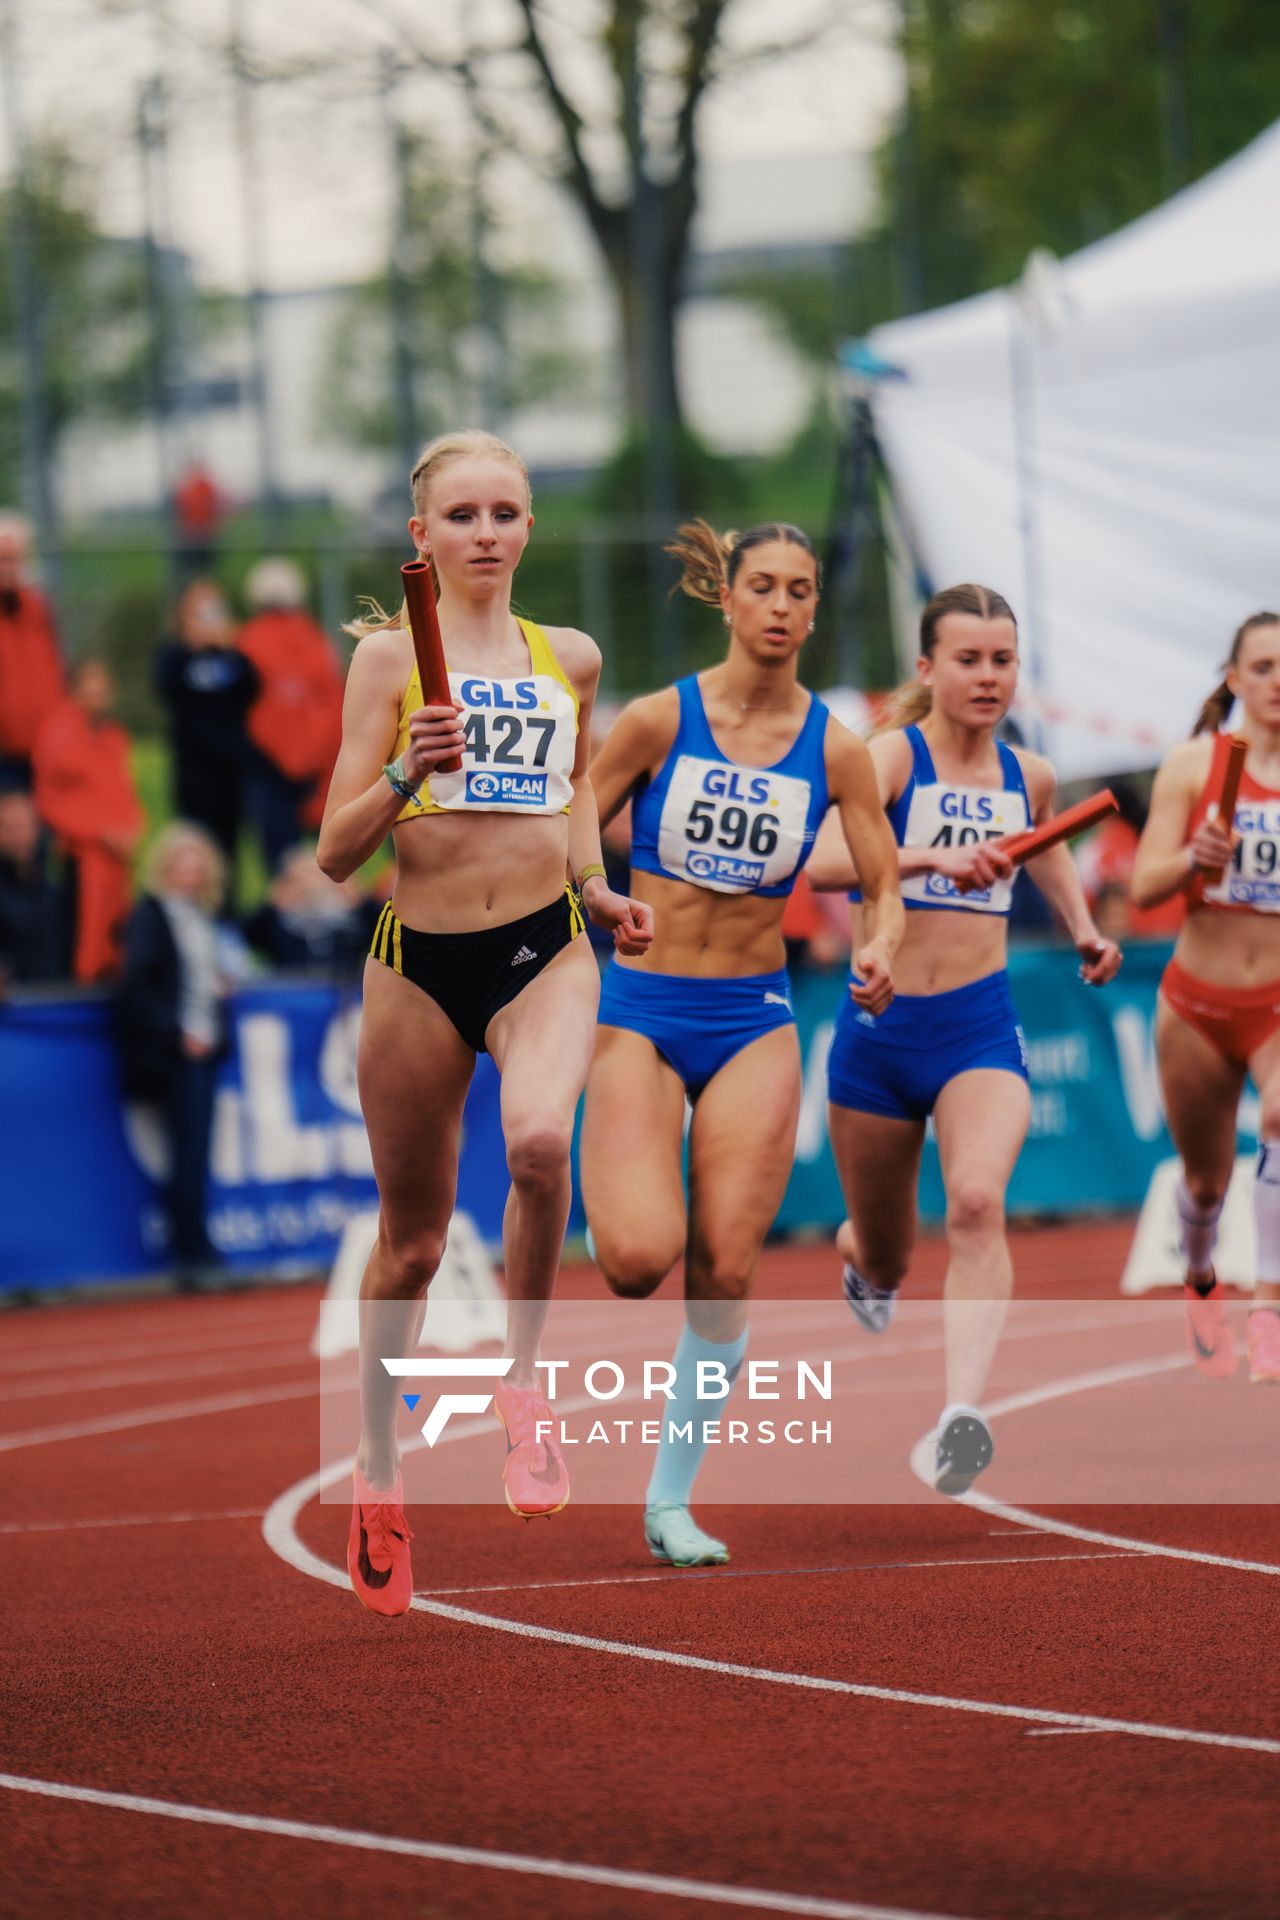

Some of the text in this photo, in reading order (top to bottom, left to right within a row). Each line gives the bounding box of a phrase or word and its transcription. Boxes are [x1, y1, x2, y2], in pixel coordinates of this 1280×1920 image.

[463, 714, 556, 767] 427
[501, 777, 543, 794] PLAN
[685, 800, 780, 857] 596
[718, 860, 761, 879] PLAN
